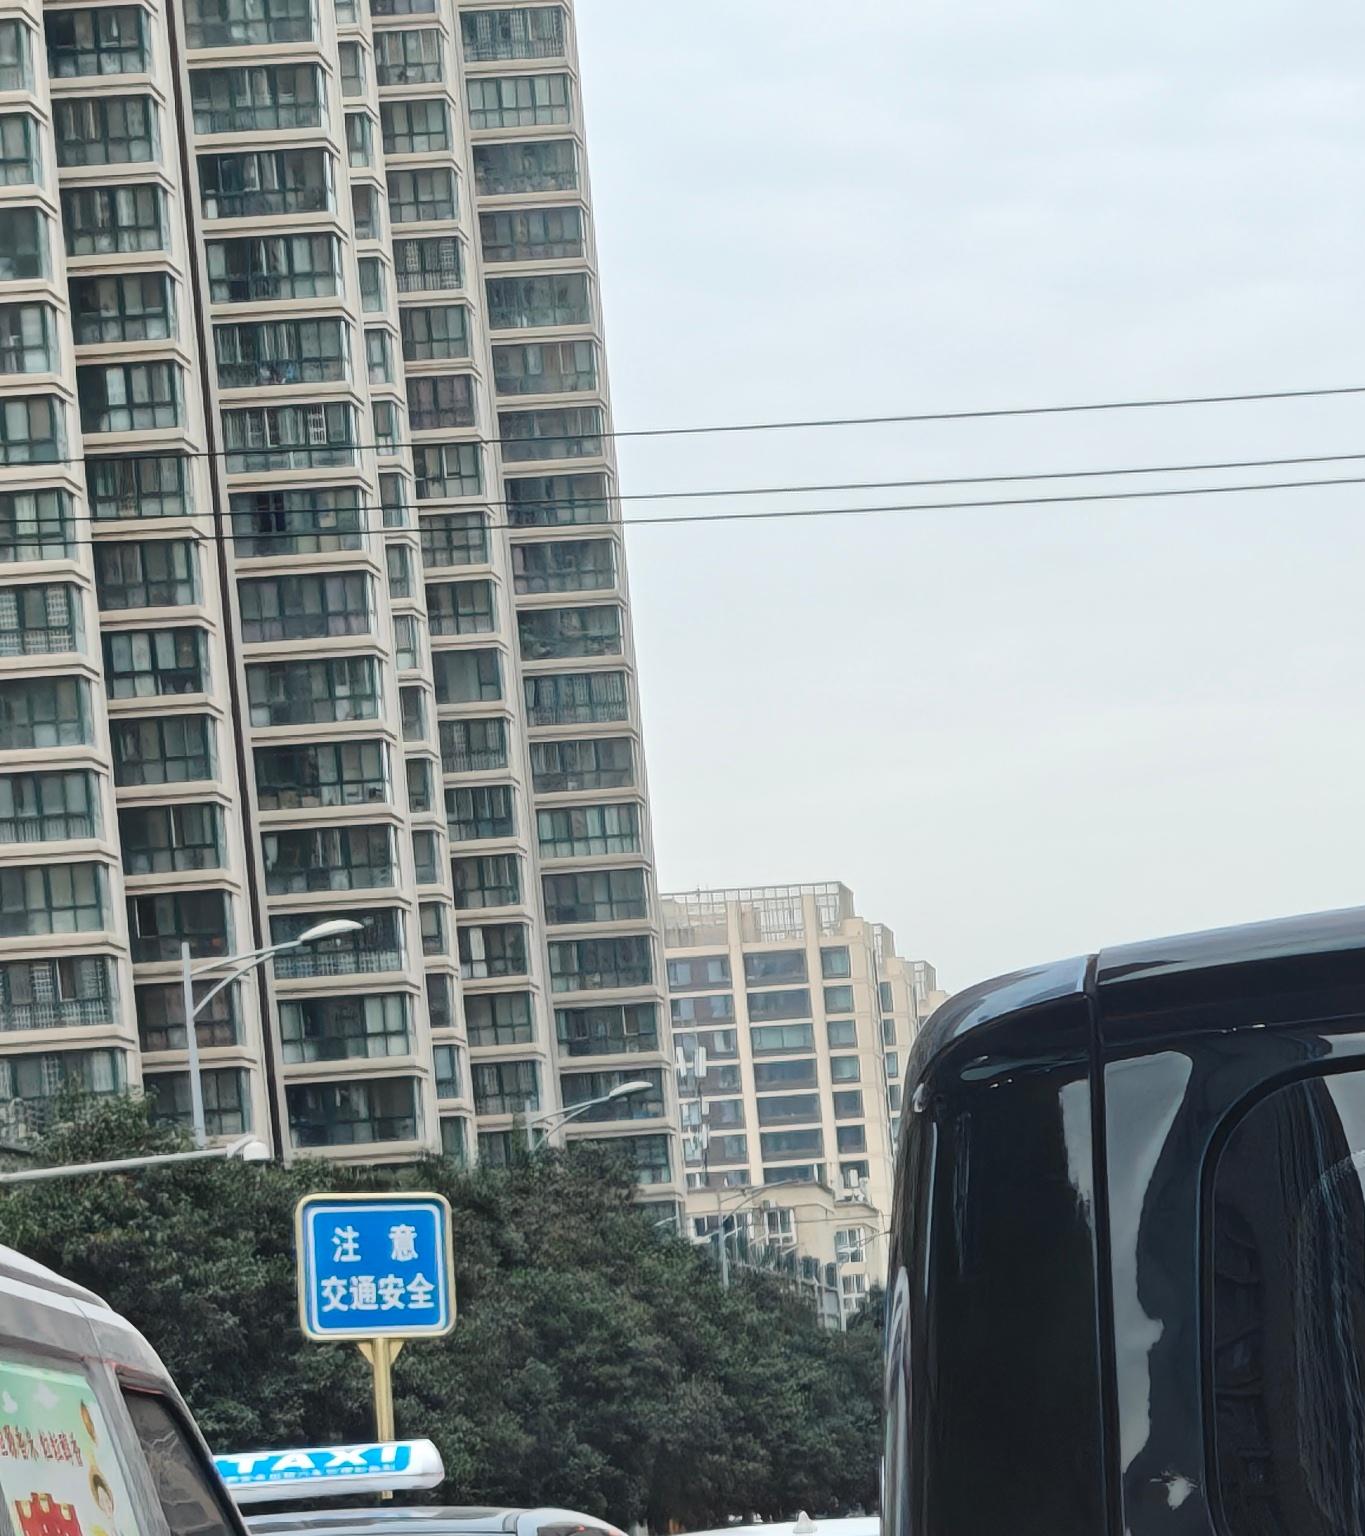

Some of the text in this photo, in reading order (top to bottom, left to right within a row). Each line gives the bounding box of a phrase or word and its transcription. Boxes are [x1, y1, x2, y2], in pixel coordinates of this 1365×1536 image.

[331, 1224, 418, 1262] 注意
[320, 1272, 435, 1312] 交通安全
[224, 1446, 397, 1475] TAXI
